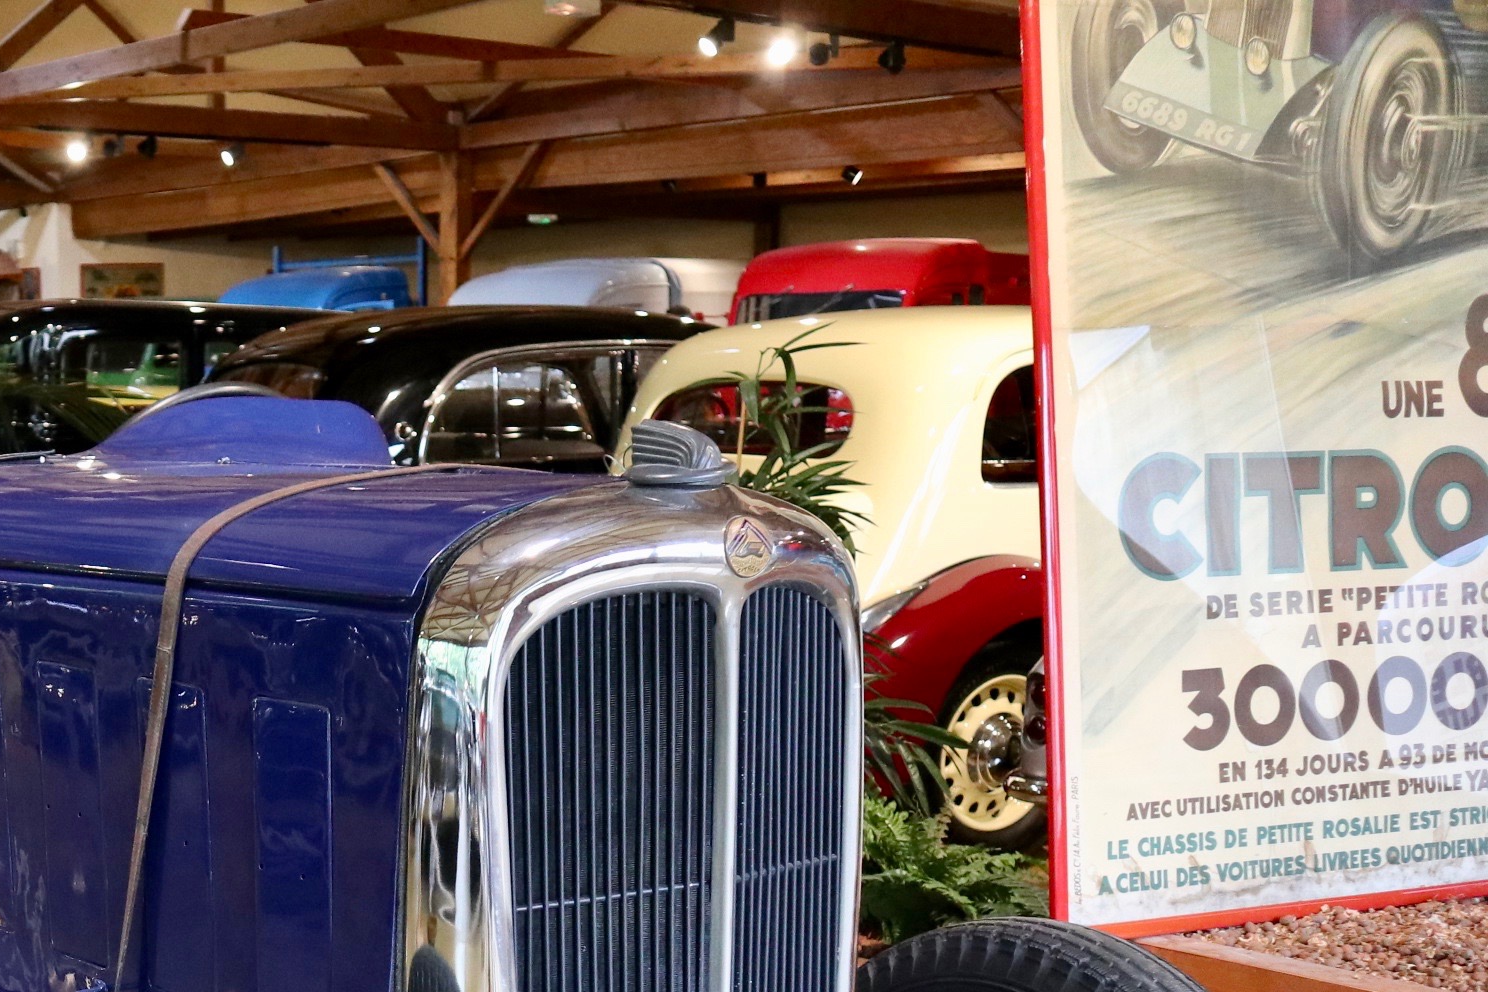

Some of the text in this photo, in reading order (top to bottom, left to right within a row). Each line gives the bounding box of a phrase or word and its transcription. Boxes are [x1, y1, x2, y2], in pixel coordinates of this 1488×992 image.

[1122, 91, 1252, 151] 6689 RG 1
[1381, 380, 1444, 419] UNE
[1206, 594, 1239, 619] DE
[1249, 588, 1333, 617] SERIE
[1301, 624, 1321, 648] A
[1219, 761, 1246, 783] EN
[1255, 758, 1288, 780] 134
[1296, 751, 1369, 777] JOURS
[1378, 750, 1394, 770] A
[1398, 743, 1426, 770] 93
[1432, 744, 1456, 764] DE
[1071, 776, 1079, 799] PARIS
[1127, 800, 1172, 821] AVEC
[1176, 789, 1284, 816] UTILISATION
[1291, 780, 1391, 805] CONSTANTE
[1107, 806, 1488, 860] LE CHASSIS DE PETITE ROSALIE EST STRI
[1098, 875, 1113, 896] A
[1116, 869, 1168, 894] CELUI
[1176, 865, 1210, 887] DES
[1216, 855, 1305, 882] VOITURES
[1314, 848, 1381, 873] LIVREES
